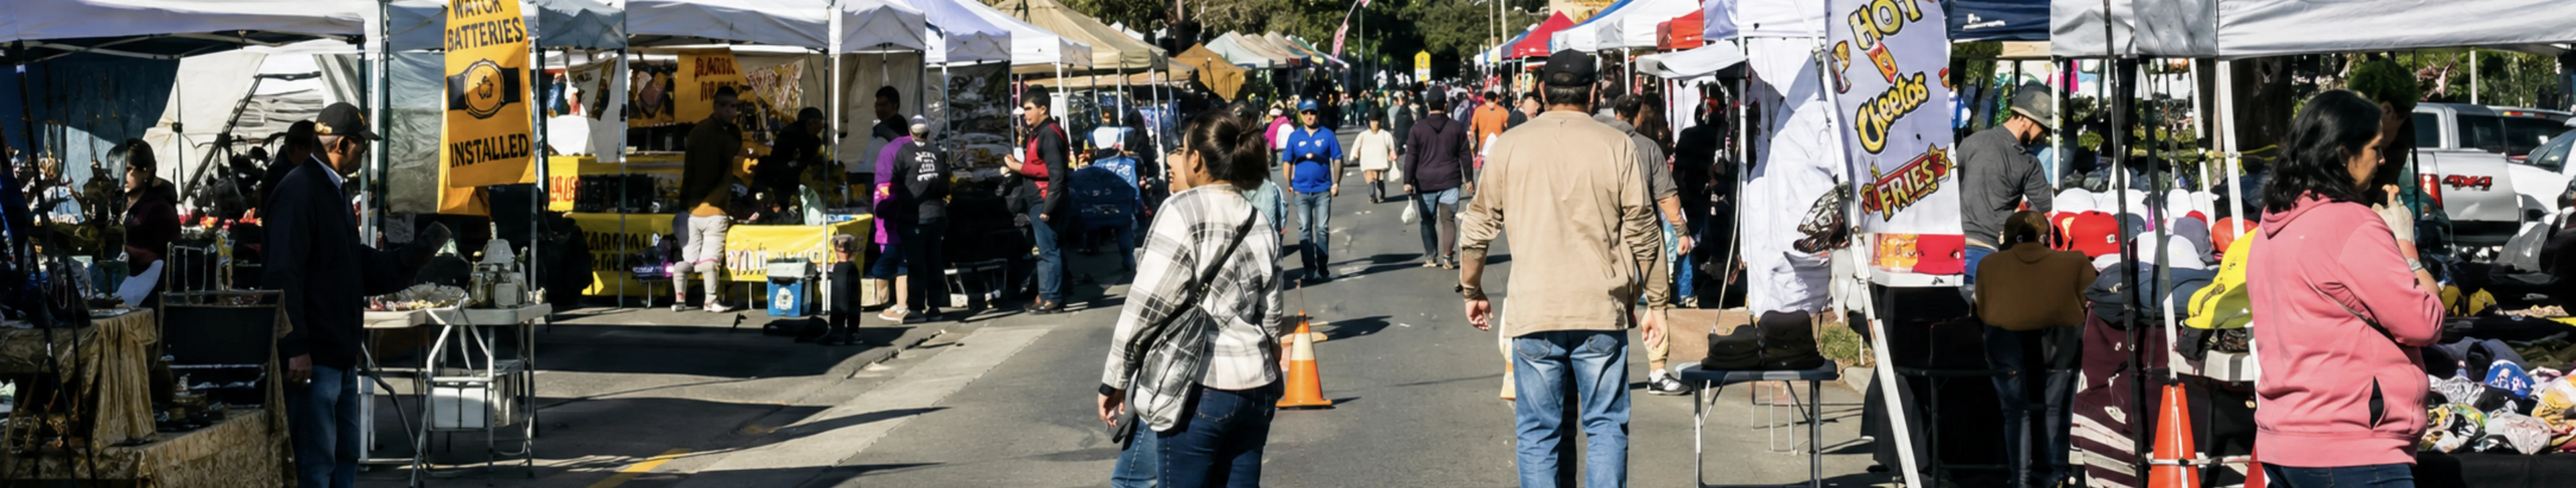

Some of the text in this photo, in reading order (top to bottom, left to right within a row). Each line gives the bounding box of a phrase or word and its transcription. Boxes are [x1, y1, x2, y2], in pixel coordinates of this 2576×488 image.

[447, 17, 523, 52] BATTERIES
[1847, 0, 1923, 50] HOT
[1855, 71, 1929, 154] Cheetos
[449, 133, 529, 168] INSTALLED
[1876, 158, 1937, 222] FRIES
